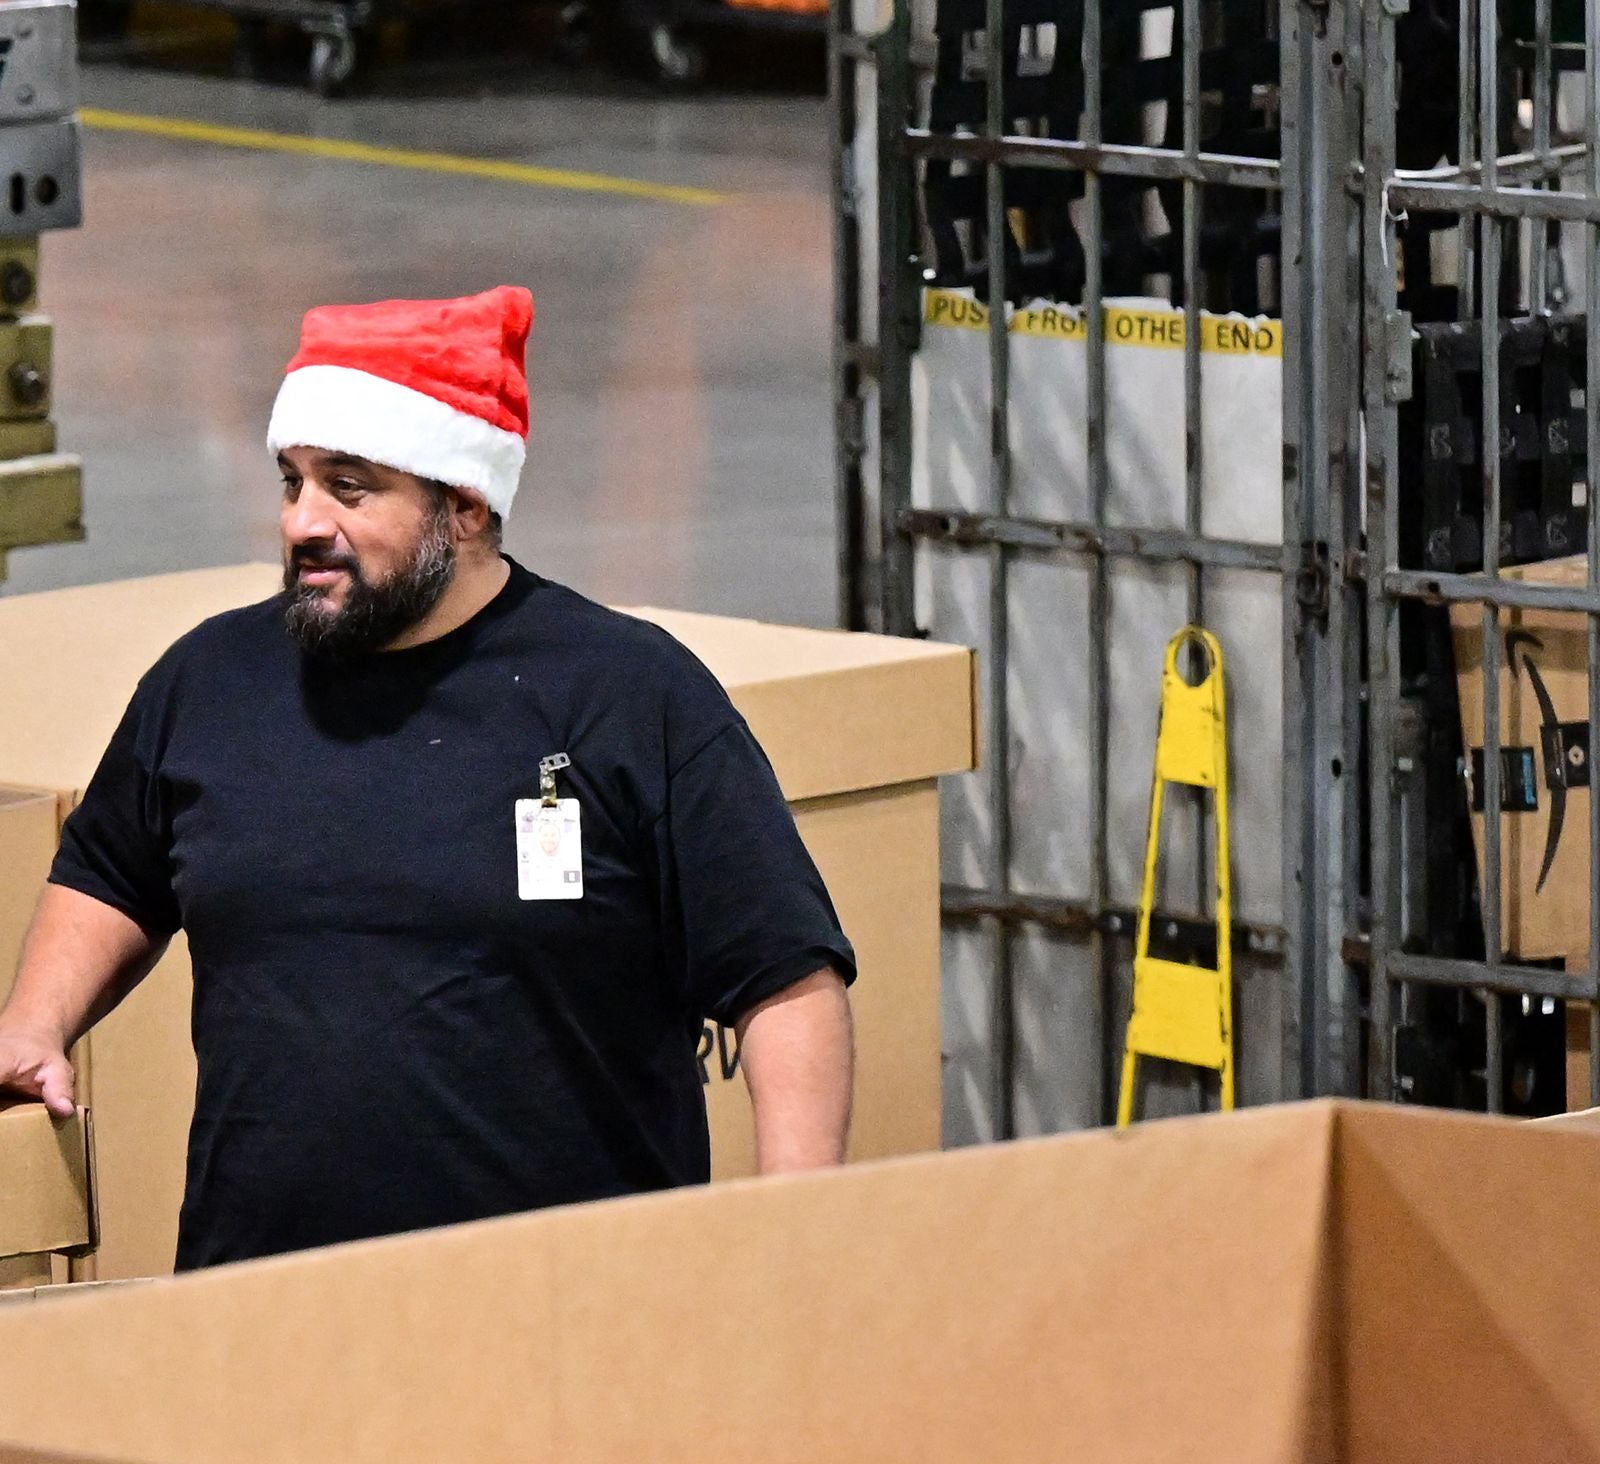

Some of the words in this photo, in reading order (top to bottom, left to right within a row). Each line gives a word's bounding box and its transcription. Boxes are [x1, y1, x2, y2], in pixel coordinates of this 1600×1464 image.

[936, 297, 985, 323] PUS
[1026, 307, 1088, 334] FRO
[1115, 313, 1182, 343] OTHE
